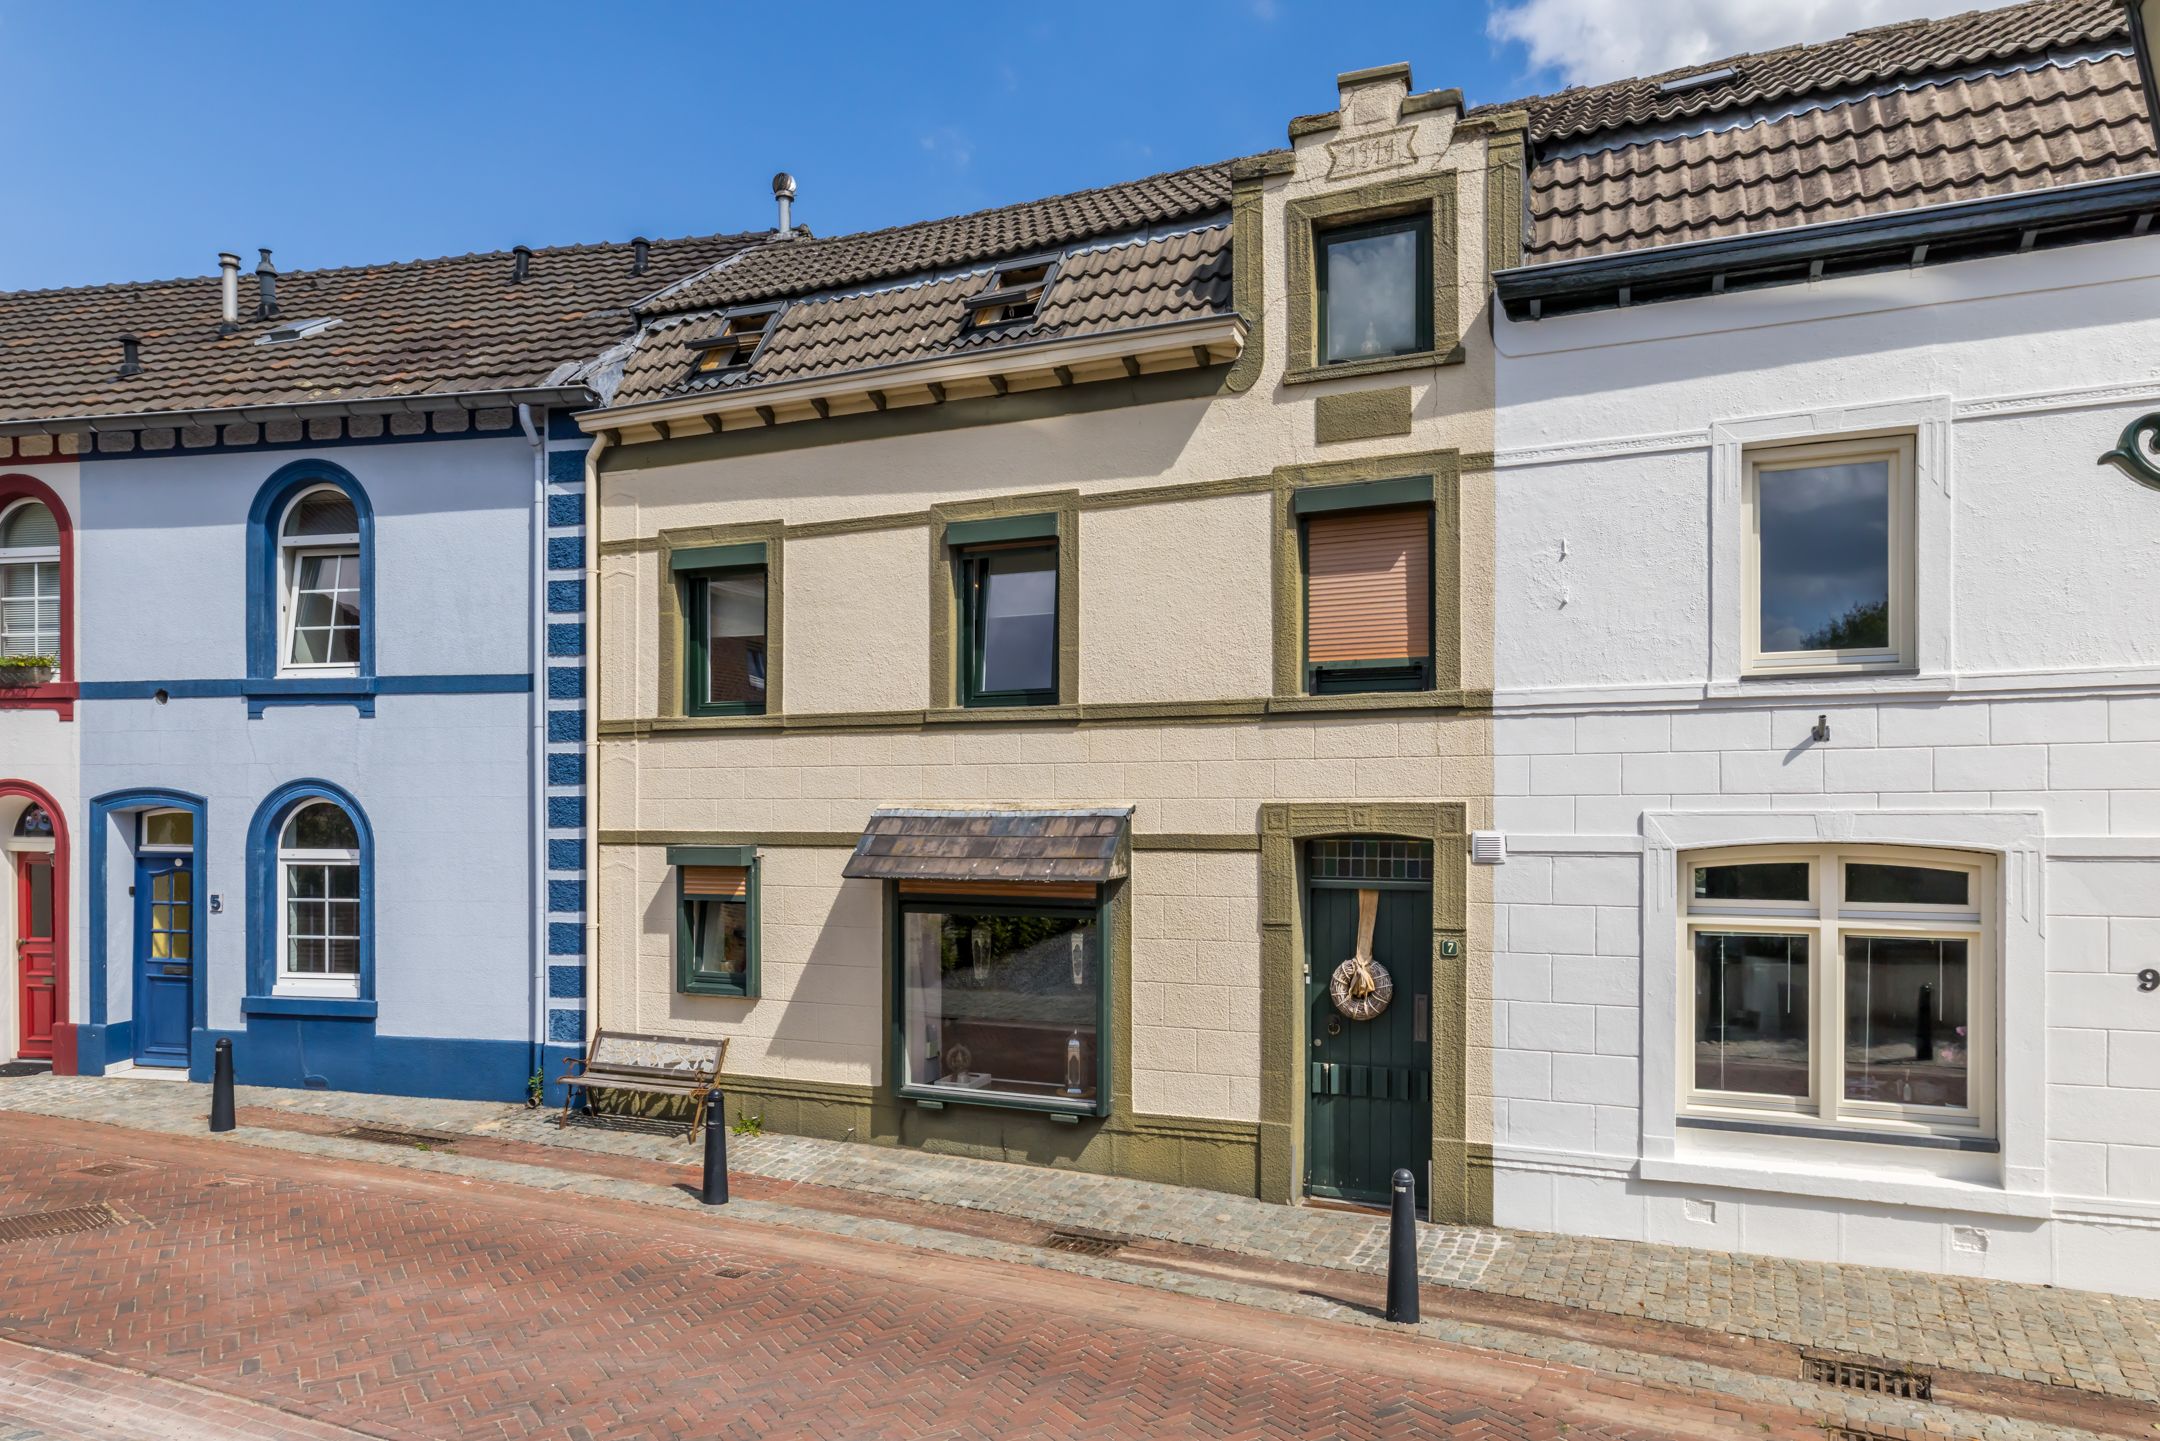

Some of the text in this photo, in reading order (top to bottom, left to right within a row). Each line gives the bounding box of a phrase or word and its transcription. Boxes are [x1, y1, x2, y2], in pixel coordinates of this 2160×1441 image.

[210, 895, 221, 911] 5
[1447, 942, 1454, 953] 7
[2138, 968, 2160, 992] 9
